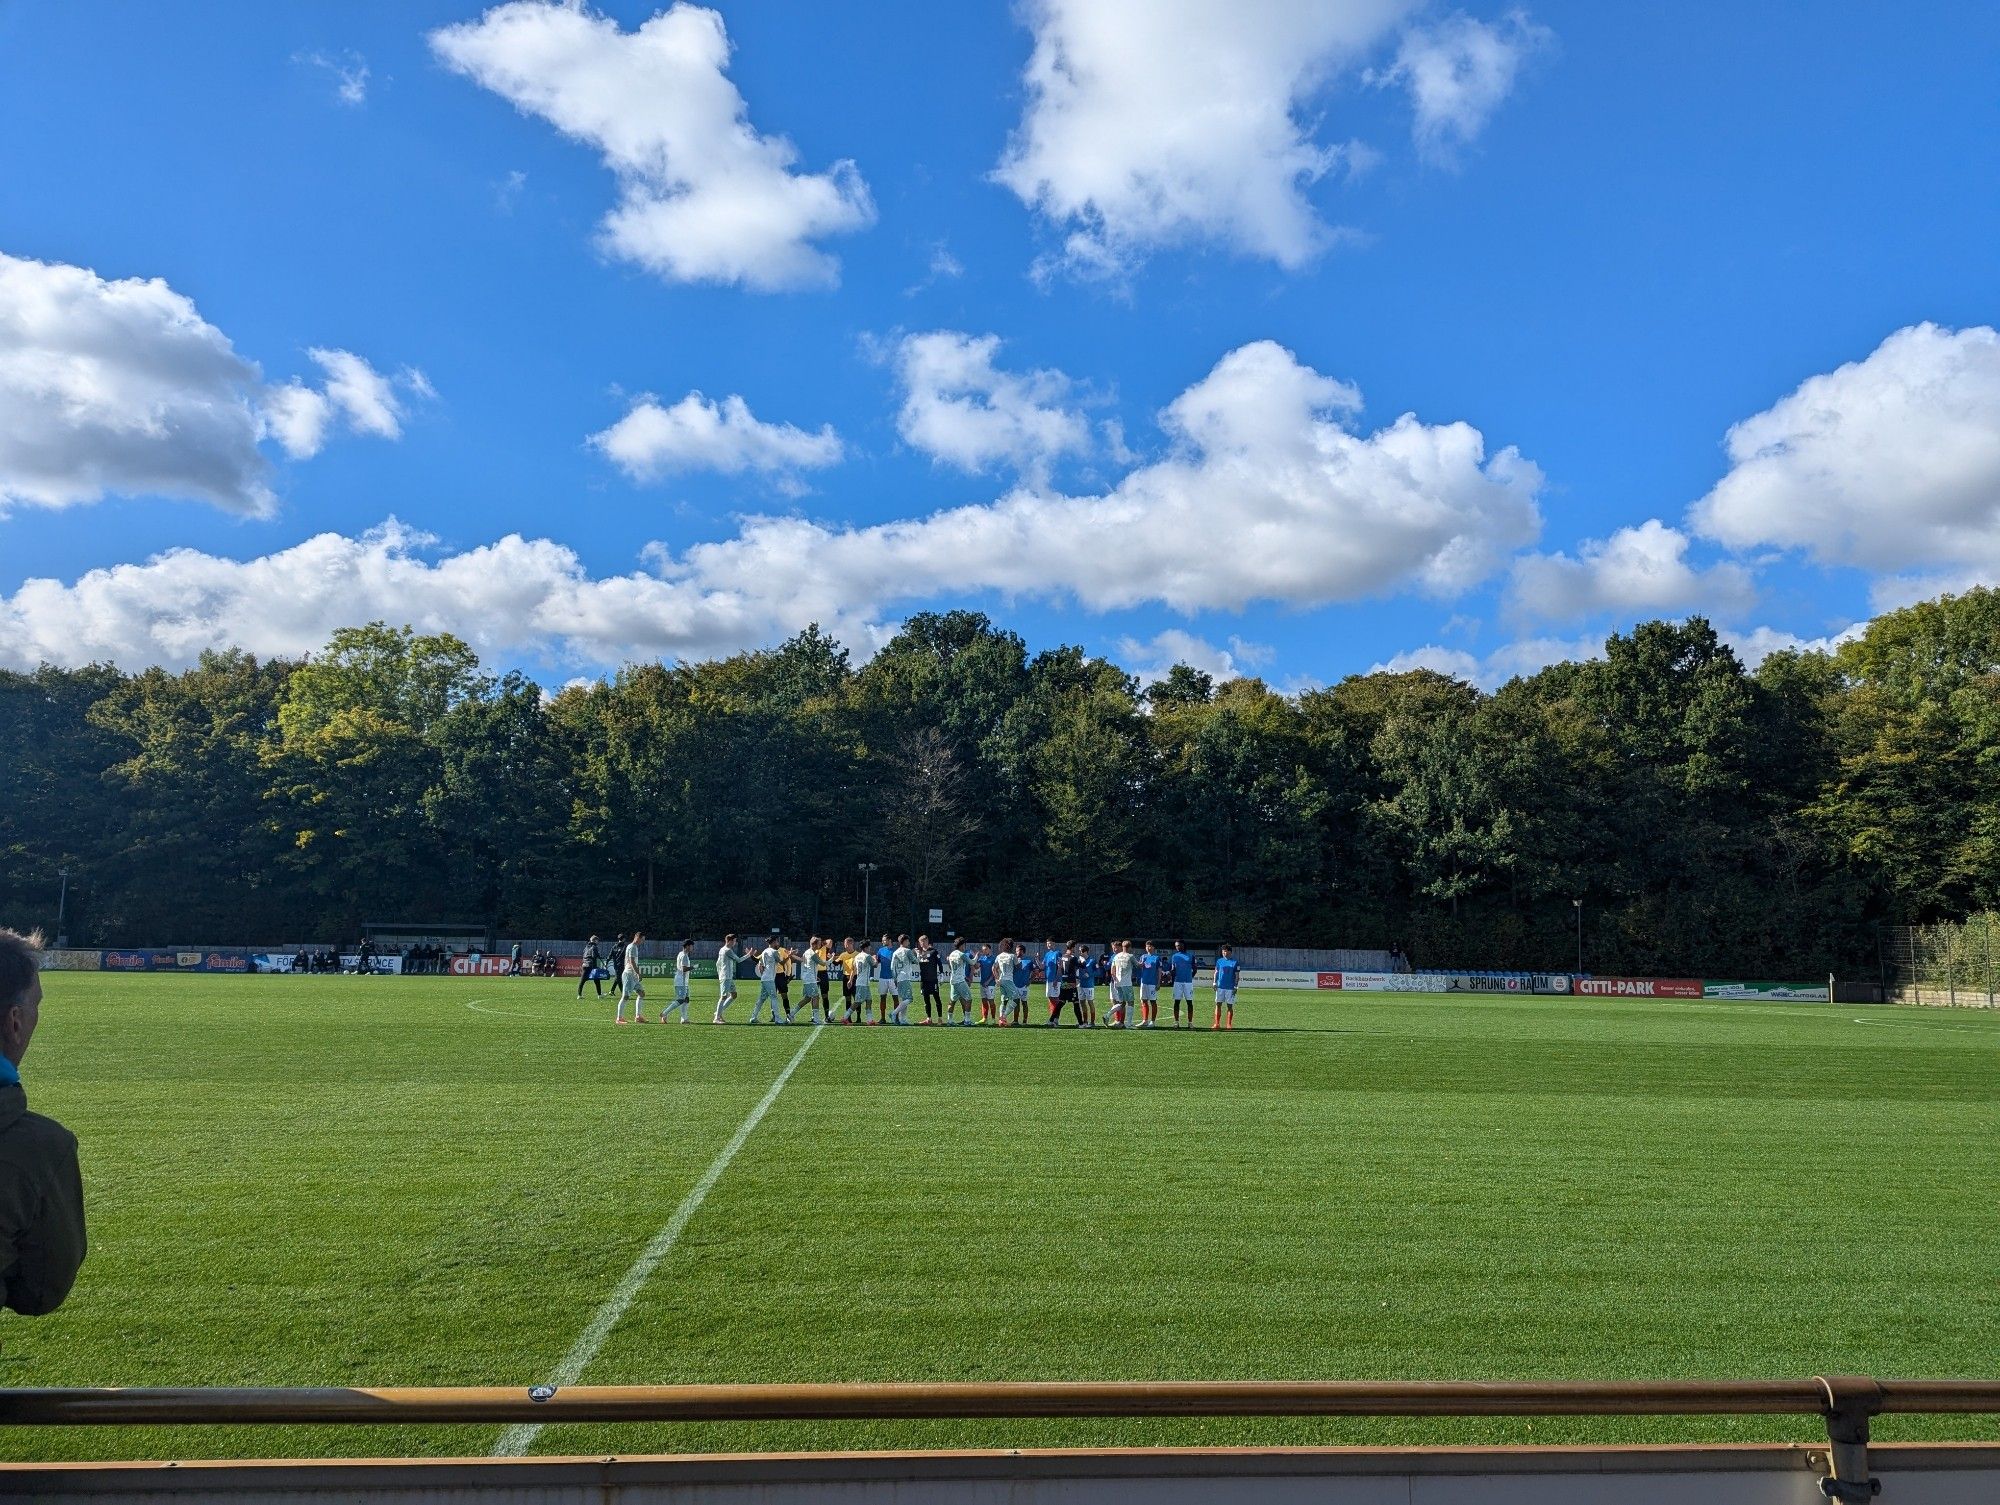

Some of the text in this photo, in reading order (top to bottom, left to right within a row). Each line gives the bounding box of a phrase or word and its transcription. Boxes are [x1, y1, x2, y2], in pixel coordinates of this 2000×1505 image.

[354, 957, 394, 969] SRVICE
[1469, 976, 1505, 991] SPRUNG
[1580, 979, 1655, 995] CITTI-PARK
